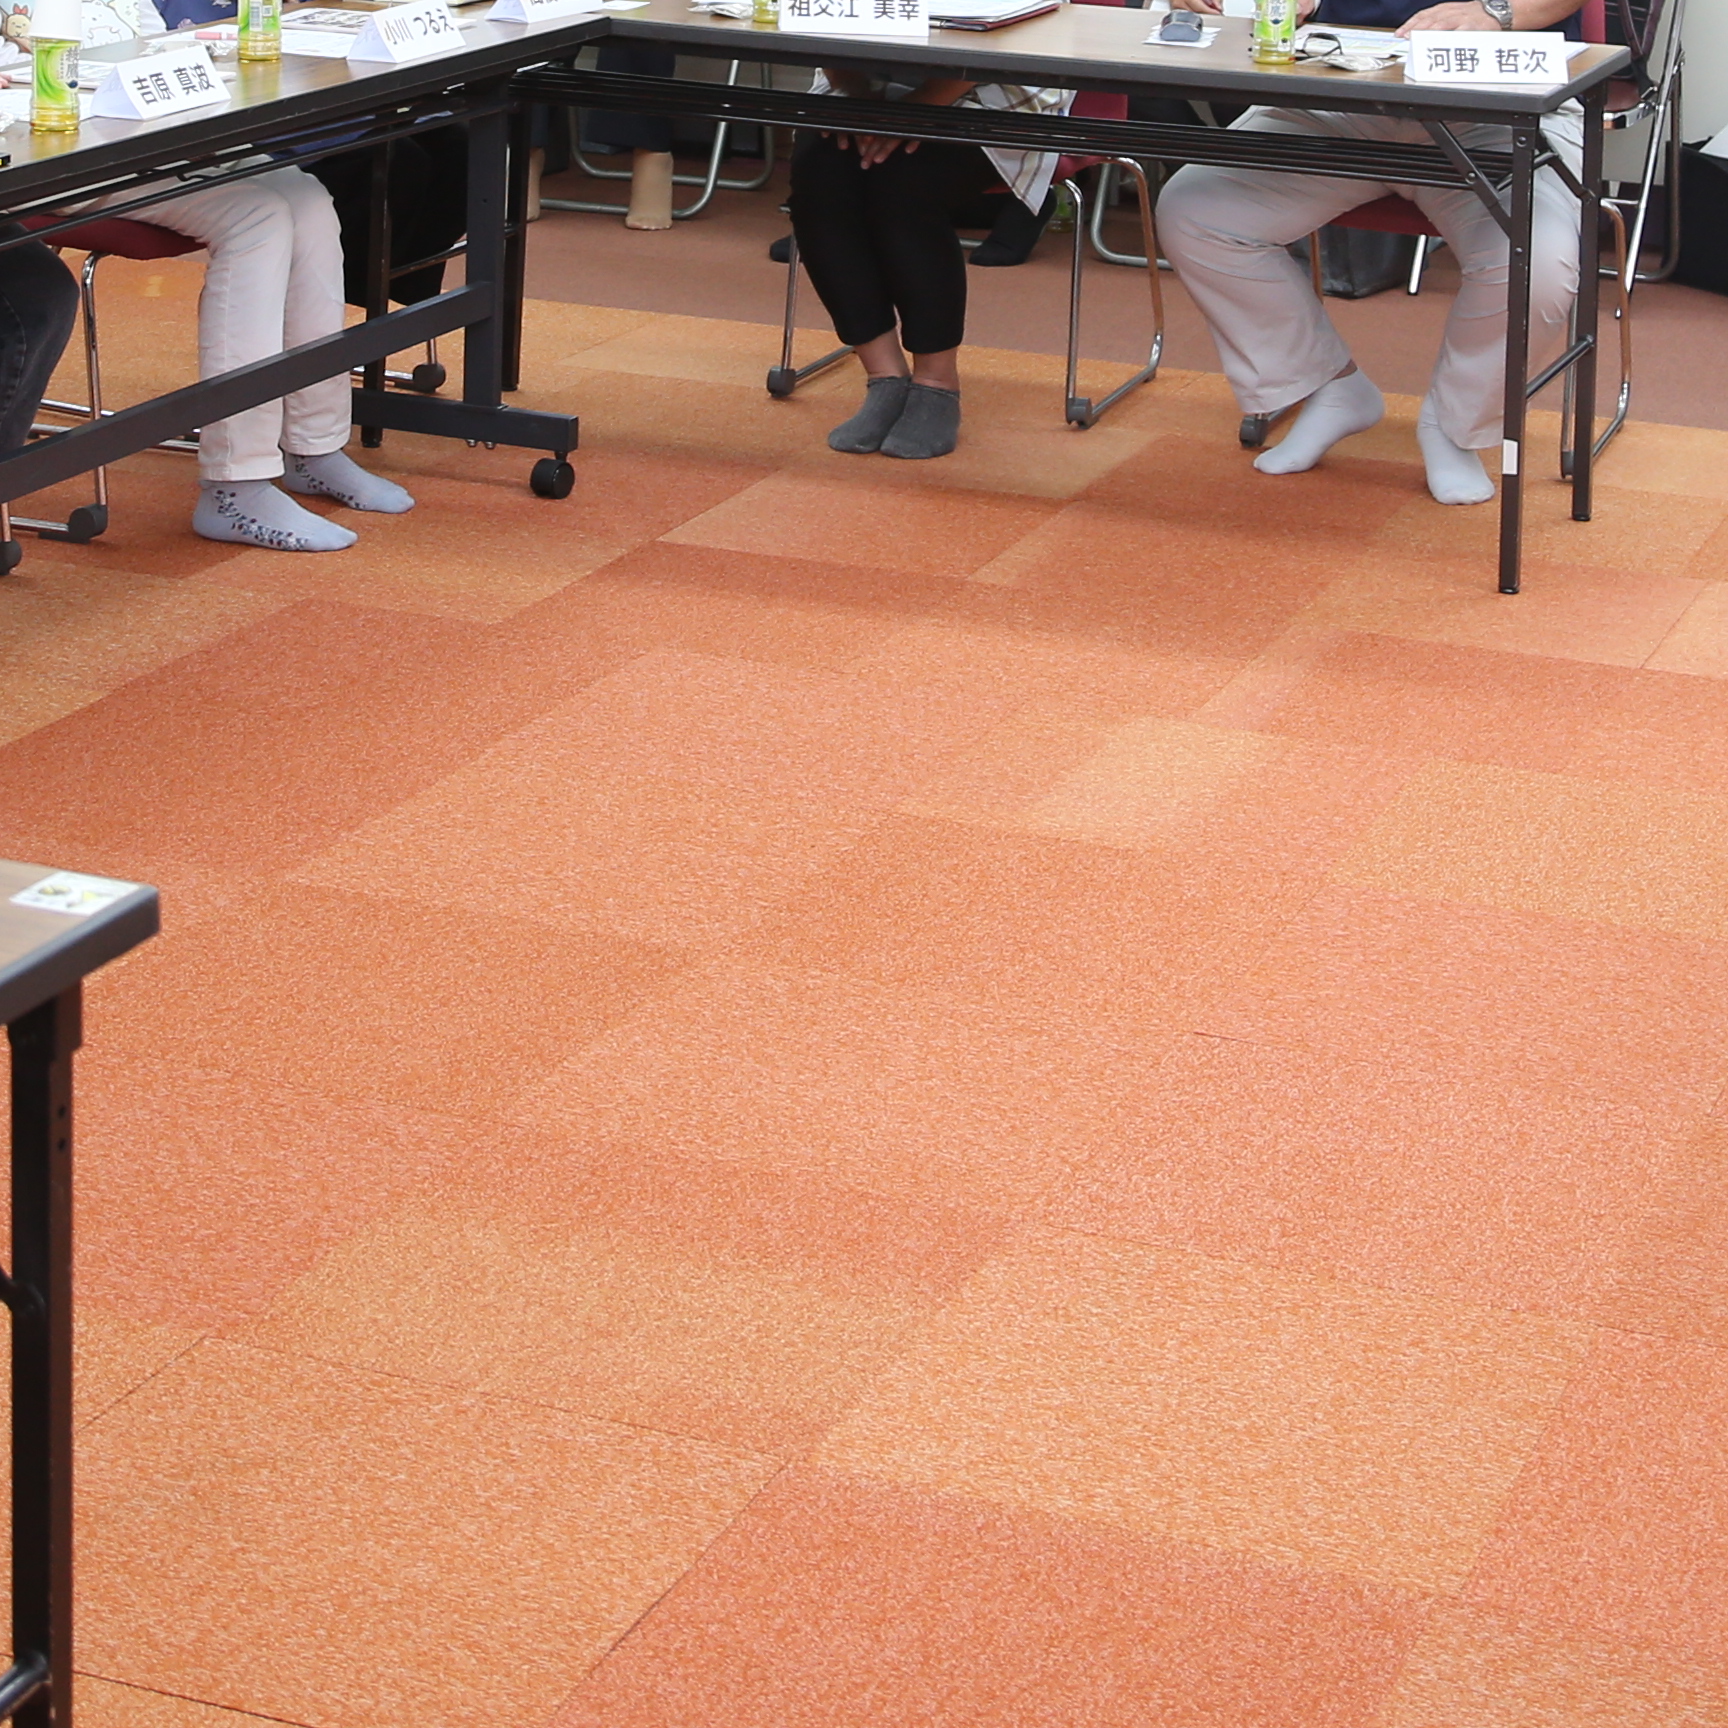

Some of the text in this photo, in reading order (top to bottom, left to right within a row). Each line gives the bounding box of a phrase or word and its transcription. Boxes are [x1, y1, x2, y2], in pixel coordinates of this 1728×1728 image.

[383, 8, 455, 45] 小川 つるえ
[1426, 47, 1550, 74] 河野 哲次
[132, 62, 215, 105] 吉原 真波
